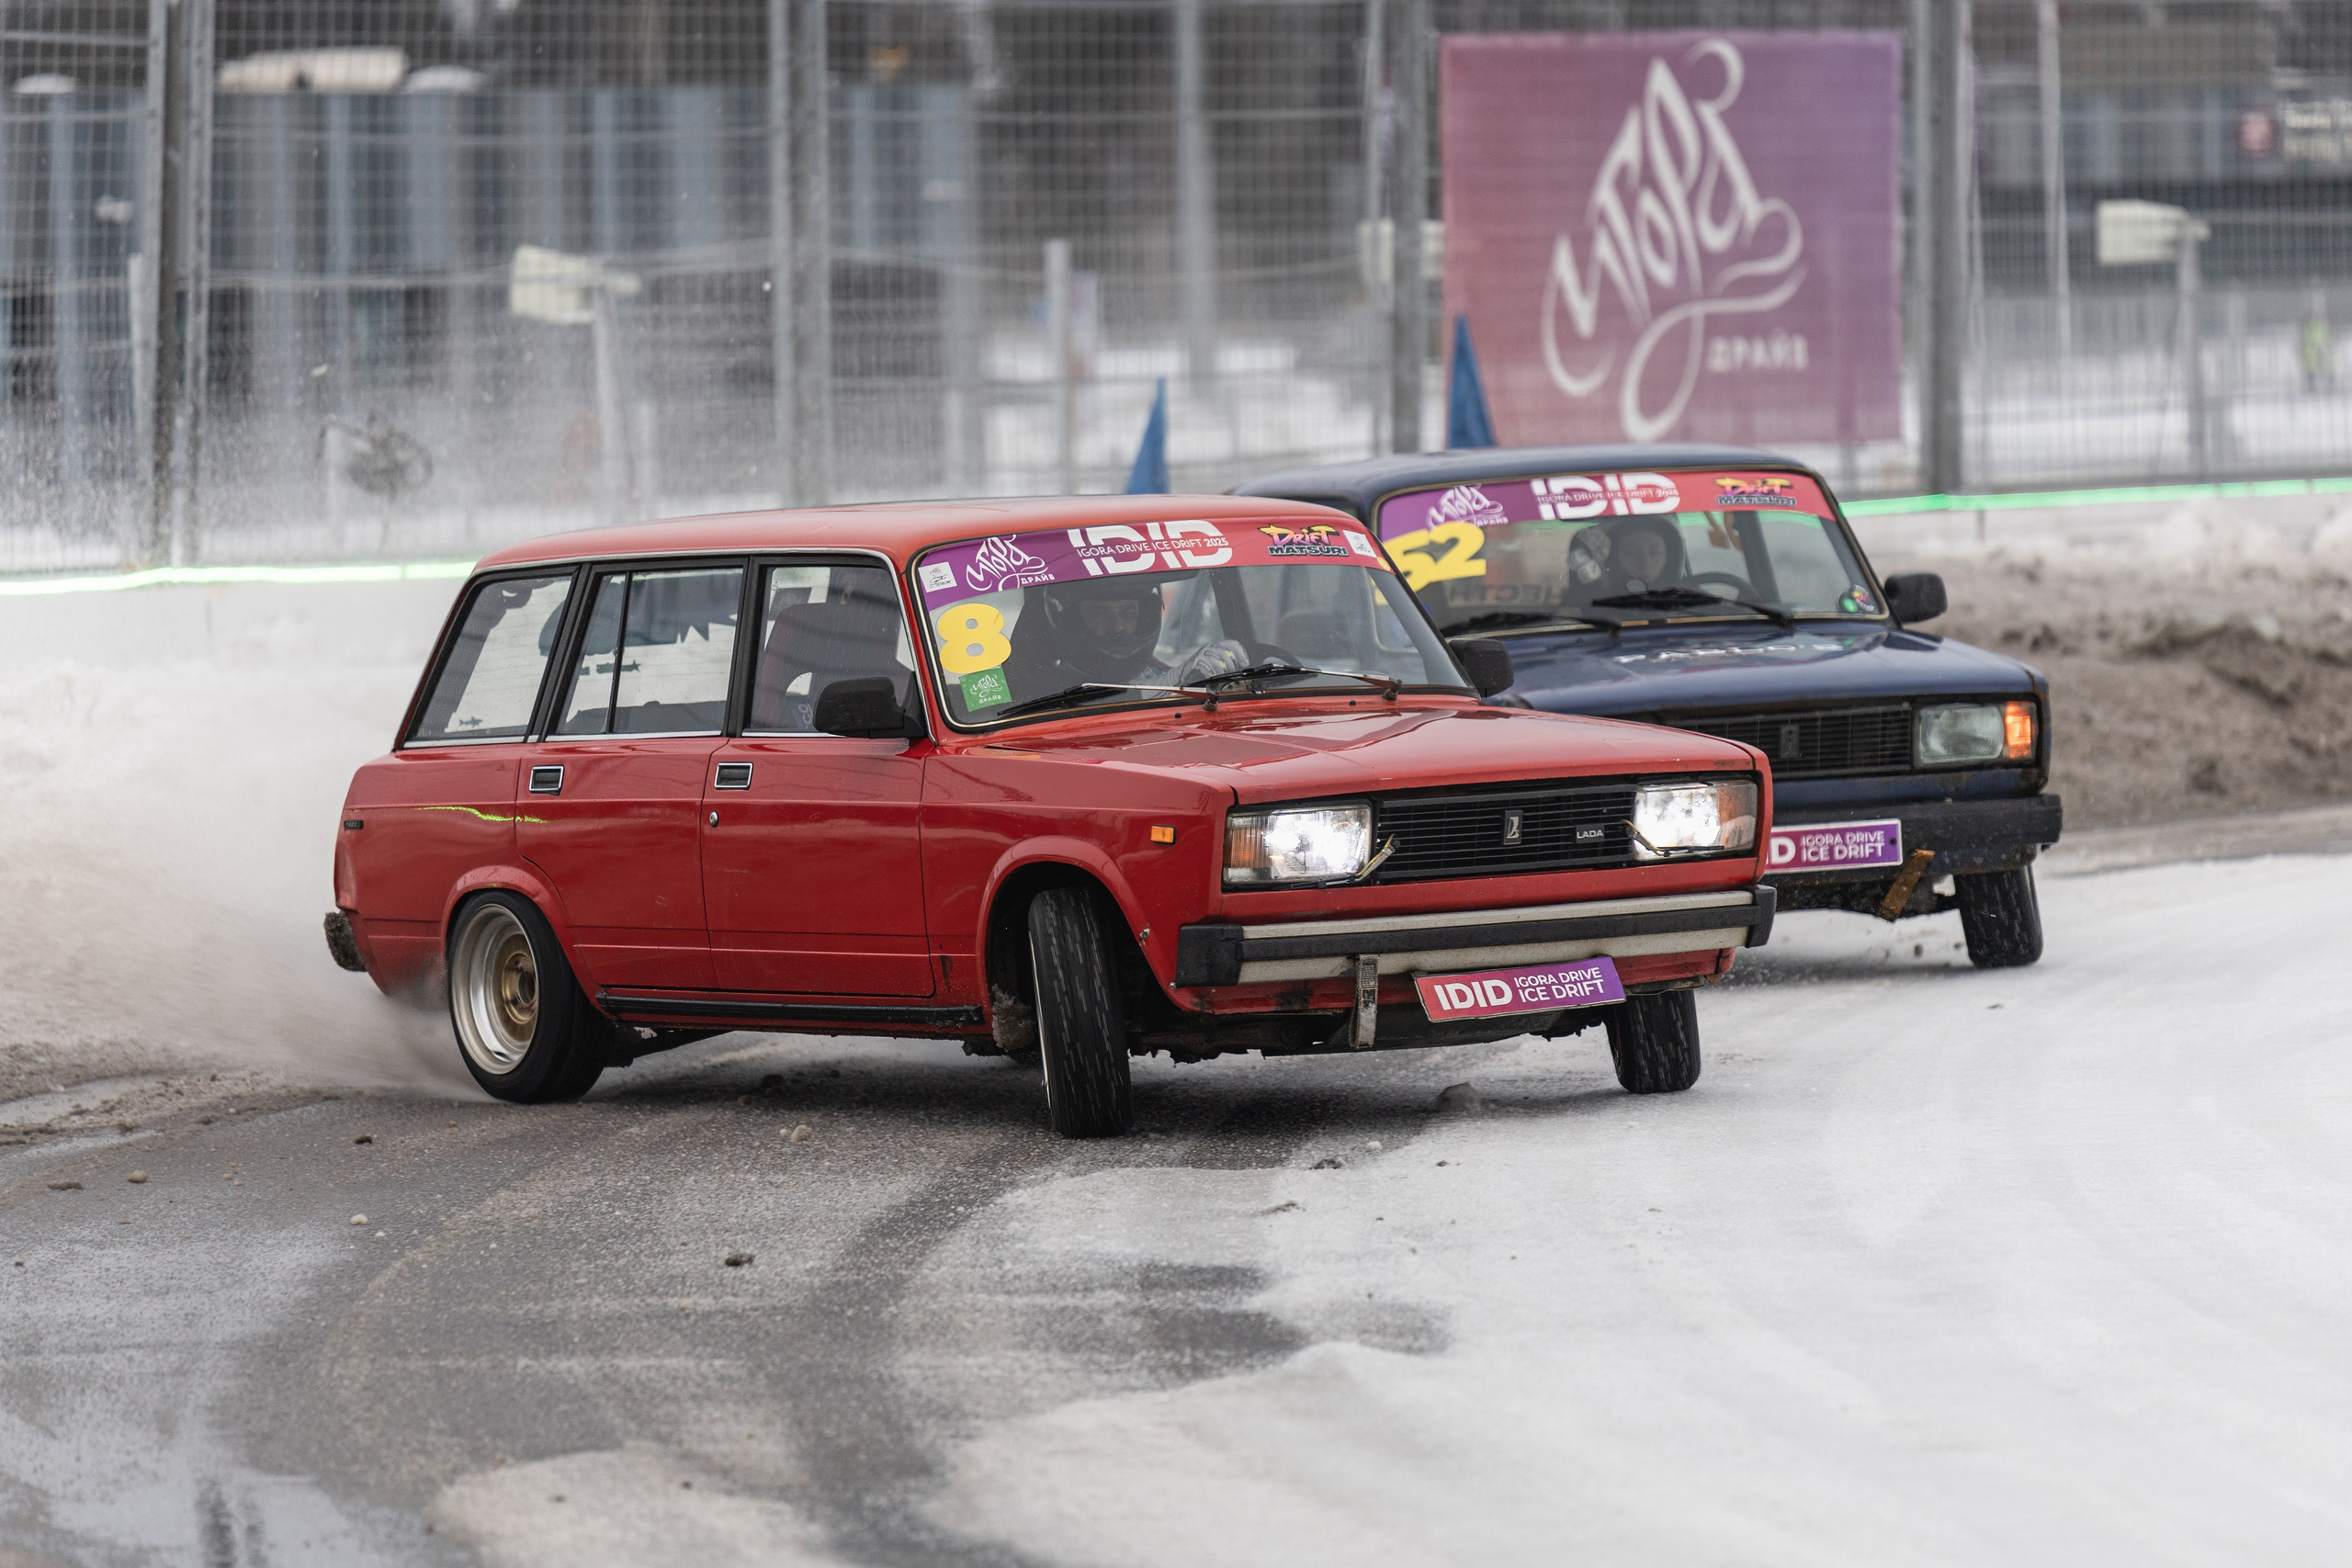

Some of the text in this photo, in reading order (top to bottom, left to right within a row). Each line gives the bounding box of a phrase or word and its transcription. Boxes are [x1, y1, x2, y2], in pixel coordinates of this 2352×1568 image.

[1531, 471, 1680, 521] IDID
[1068, 520, 1232, 576] IDID
[1077, 537, 1229, 558] IGORA DRIVE ICE DRIFT 2025
[1267, 545, 1350, 557] MATSURI
[1020, 573, 1056, 585] ДРАЙВ
[937, 603, 1012, 674] 8
[1577, 829, 1604, 839] LADA
[1801, 830, 1885, 847] IGORA DRIVE
[1802, 842, 1885, 863] ICE DRIFT
[1514, 967, 1602, 988] IGORA DRIVE
[1433, 978, 1513, 1010] IDID
[1518, 979, 1604, 1003] ICE DRIFT
